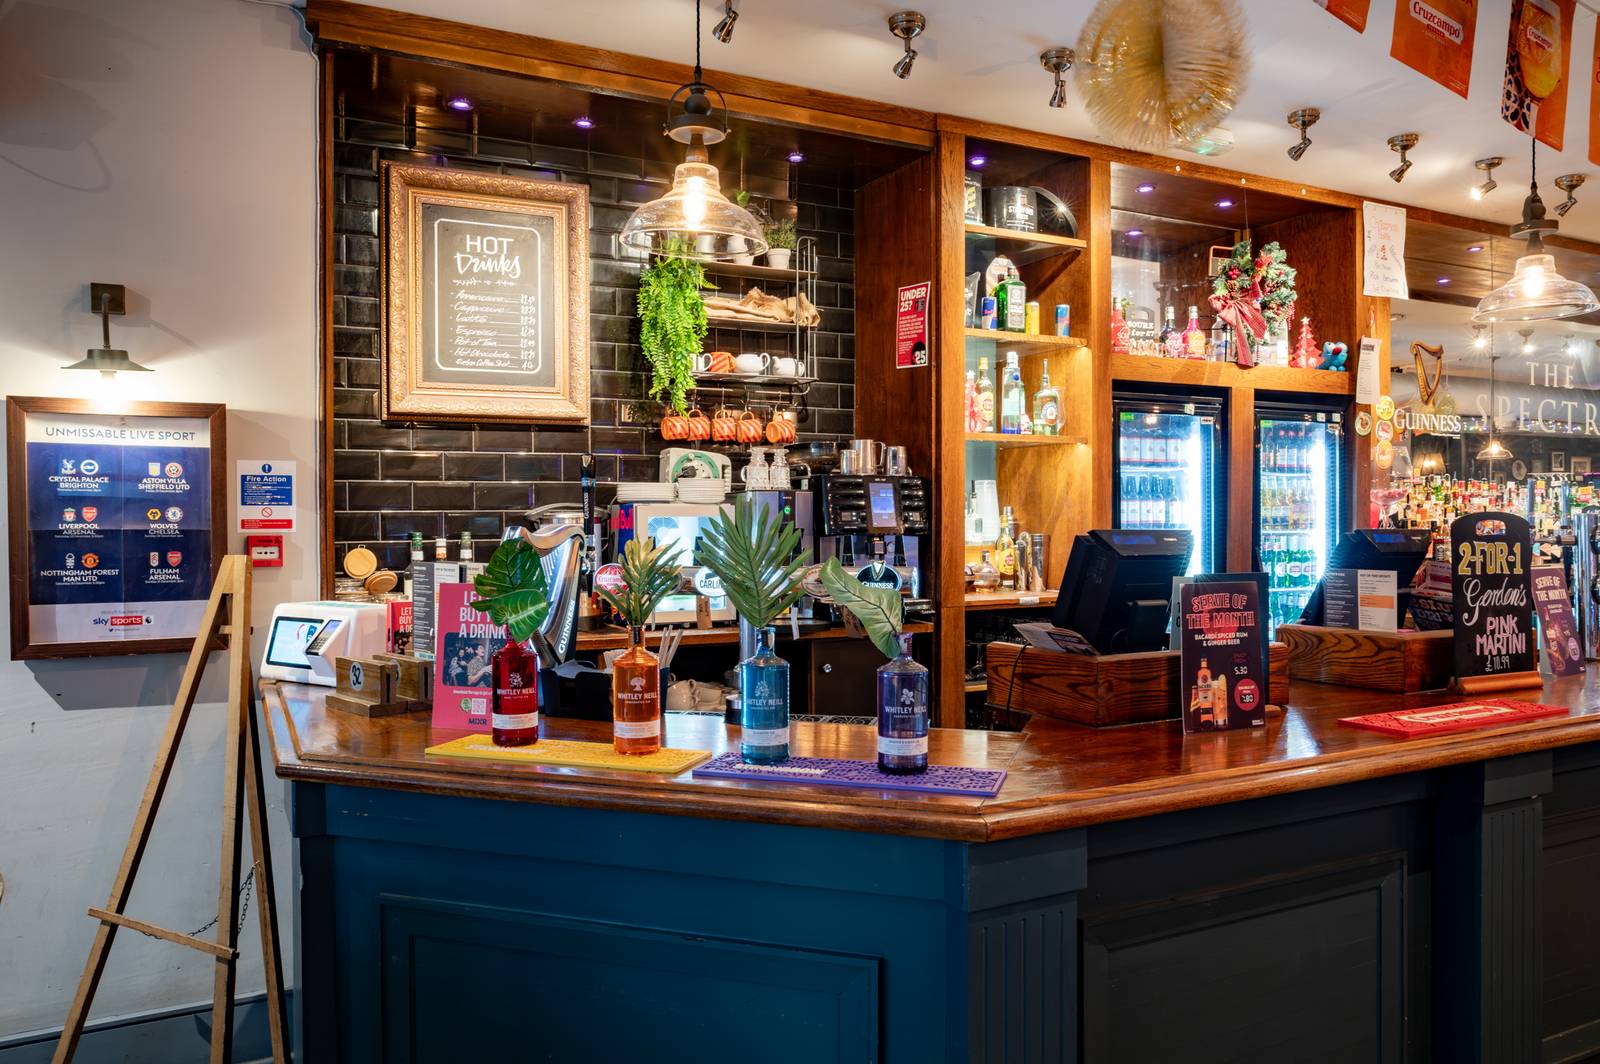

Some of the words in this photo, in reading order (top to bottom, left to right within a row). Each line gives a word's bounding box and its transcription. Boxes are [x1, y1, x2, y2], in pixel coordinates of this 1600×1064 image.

[1412, 1, 1461, 39] Cruzcampo
[466, 235, 514, 255] HOT
[454, 252, 521, 278] Drinks
[900, 287, 927, 301] UNDER
[900, 301, 913, 312] 25?
[1526, 361, 1574, 389] THE
[1393, 408, 1462, 432] GUINNESS
[45, 427, 127, 439] UNMISSABLE
[129, 430, 155, 440] LIVE
[158, 431, 196, 441] SPORT
[81, 476, 110, 484] PALACE
[1458, 542, 1523, 576] 2-FOR-1
[1192, 593, 1230, 612] SERVE
[1232, 594, 1248, 609] OF
[1462, 577, 1527, 626] Gordon's
[93, 617, 110, 627] sky
[112, 616, 142, 625] sports
[459, 607, 482, 622] BUY
[1186, 613, 1210, 629] THE
[1213, 611, 1255, 628] MONTH
[458, 624, 467, 638] A
[469, 624, 507, 639] DRINK
[558, 599, 576, 654] GUINNESS
[1486, 614, 1518, 635] PINK
[1475, 633, 1526, 657] MARTINI
[1485, 654, 1511, 672] £10.99
[351, 664, 361, 686] 32
[617, 692, 642, 700] WHITLEY
[643, 691, 657, 699] NEILL
[884, 706, 912, 714] WHITLEY
